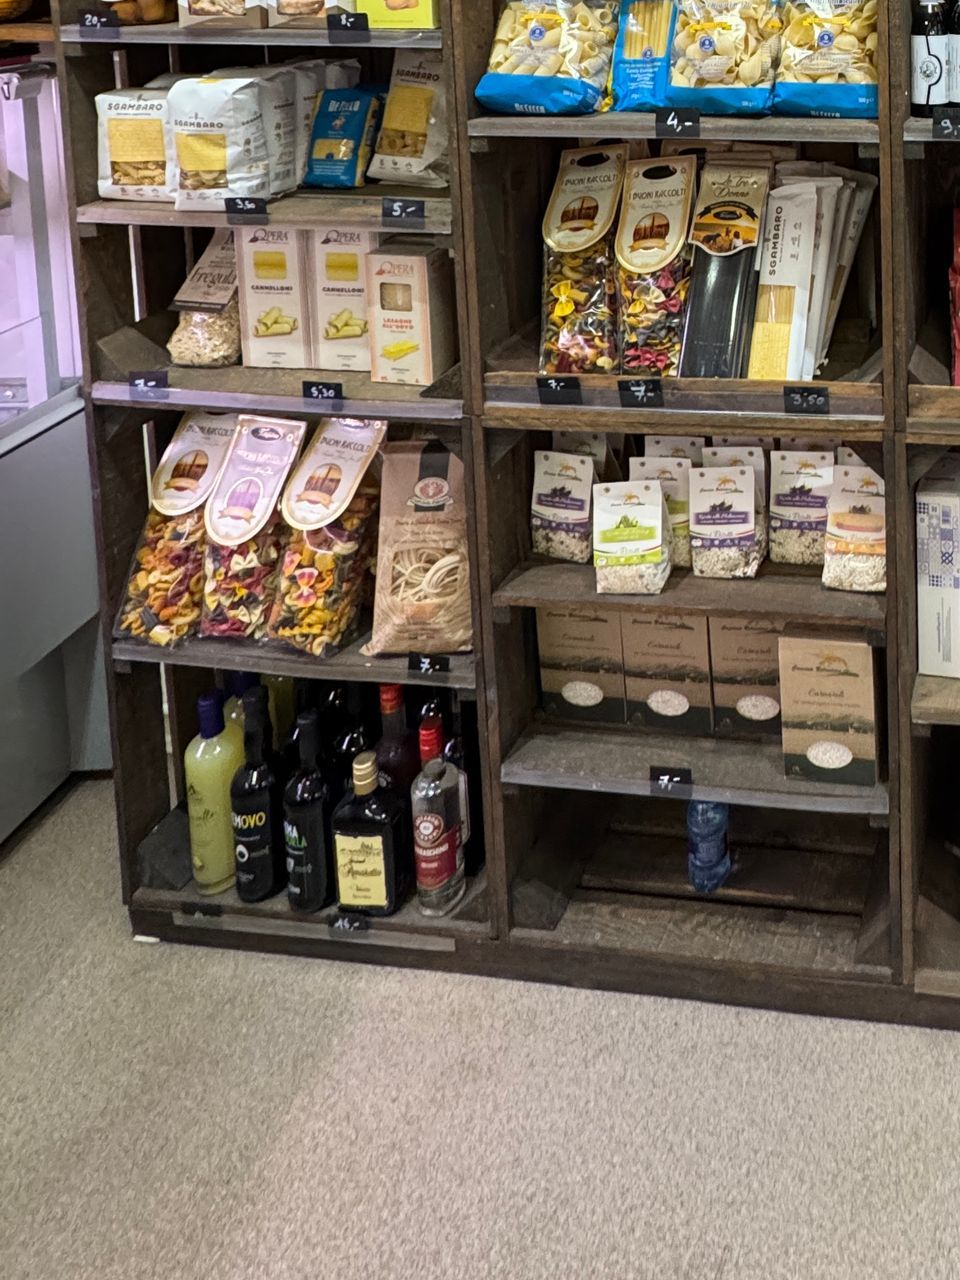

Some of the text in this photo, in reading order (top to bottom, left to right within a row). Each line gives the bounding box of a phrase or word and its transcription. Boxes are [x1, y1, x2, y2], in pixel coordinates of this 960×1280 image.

[107, 103, 163, 112] SGAMBARO
[174, 119, 224, 129] SGAMBARO
[713, 186, 751, 199] Donne
[768, 206, 784, 277] SGAMBARO
[250, 284, 293, 292] CANNELLONI
[322, 286, 365, 294] CANNELLONI
